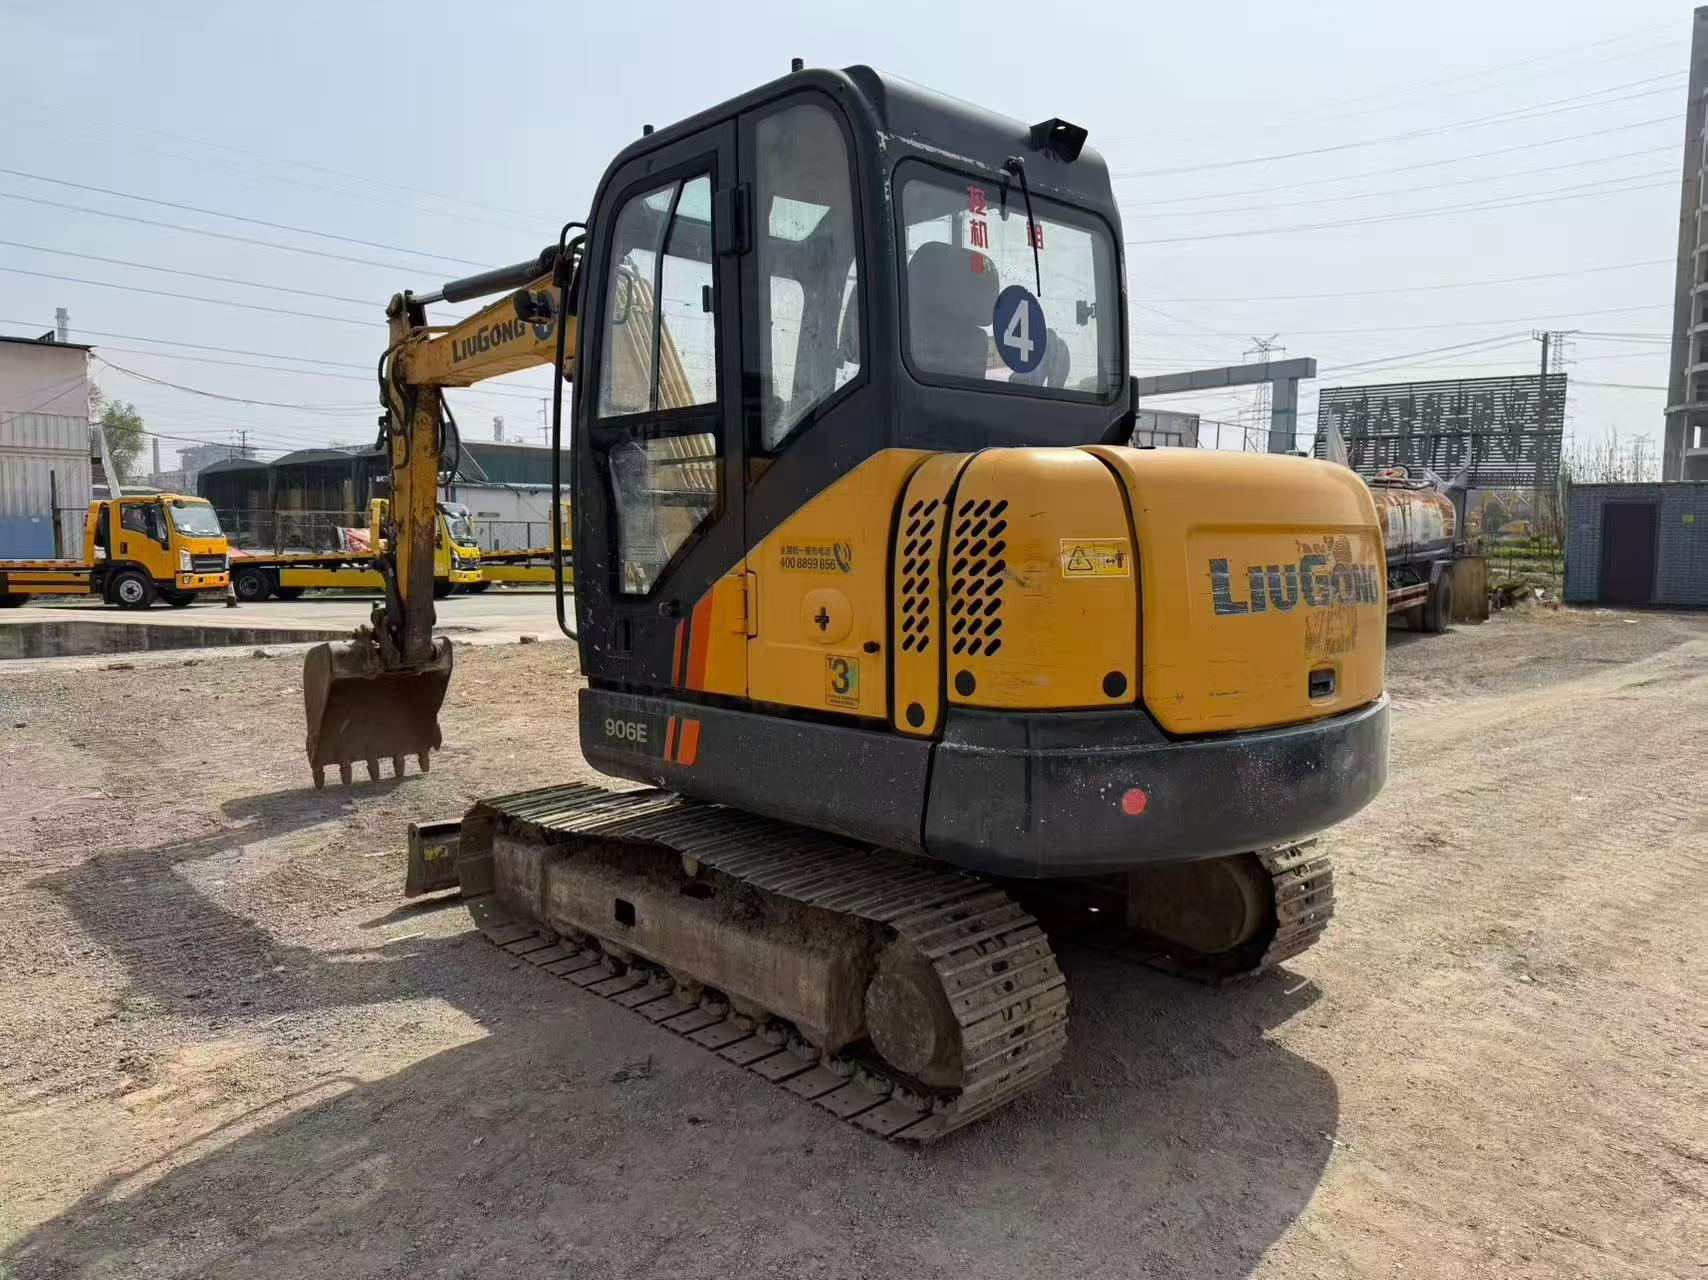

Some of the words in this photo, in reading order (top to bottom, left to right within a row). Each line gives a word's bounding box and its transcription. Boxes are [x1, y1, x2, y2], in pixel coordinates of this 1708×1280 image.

[452, 317, 526, 364] LIUGONG
[1003, 299, 1034, 362] 4
[780, 556, 796, 569] 400
[605, 718, 647, 743] 906E
